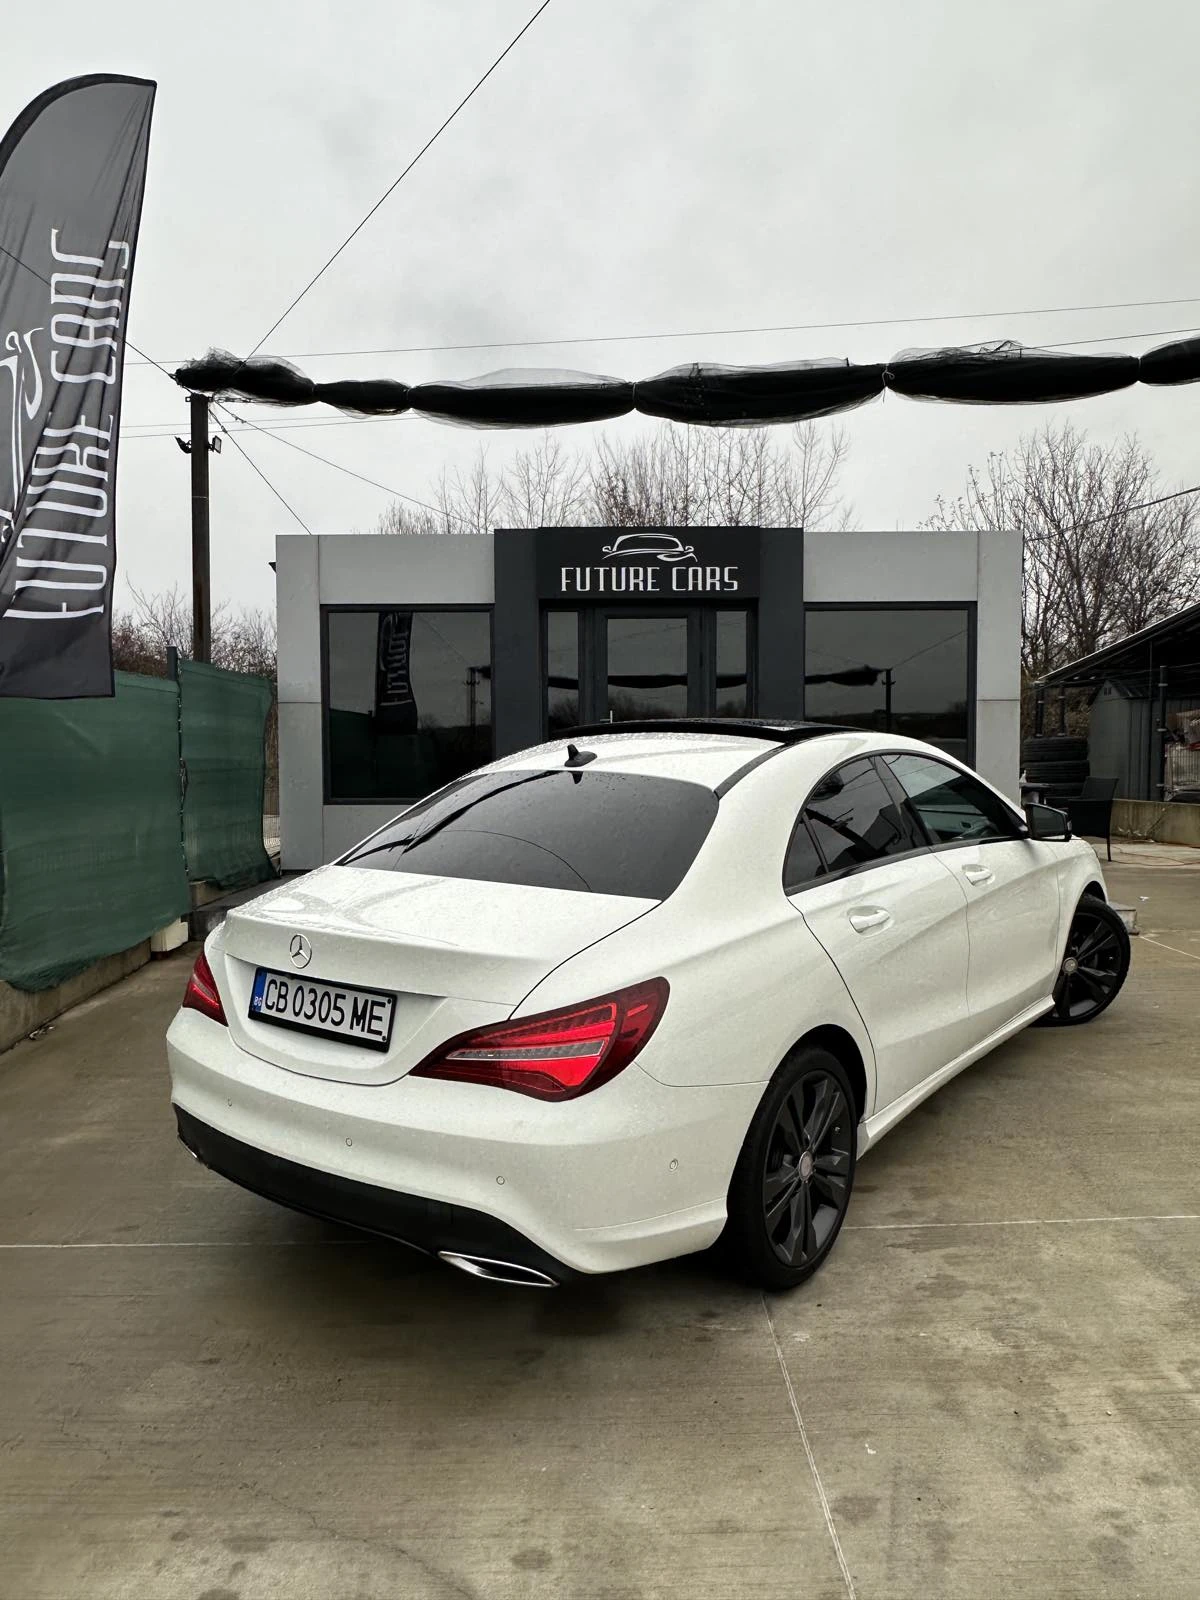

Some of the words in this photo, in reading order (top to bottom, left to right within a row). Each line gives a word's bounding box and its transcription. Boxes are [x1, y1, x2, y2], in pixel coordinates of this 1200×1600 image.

[50, 228, 130, 385] CARS
[561, 567, 660, 591] FUTURE
[672, 567, 739, 591] CARS
[264, 979, 289, 1013] CB
[292, 985, 346, 1026] 0305
[350, 996, 386, 1036] ME
